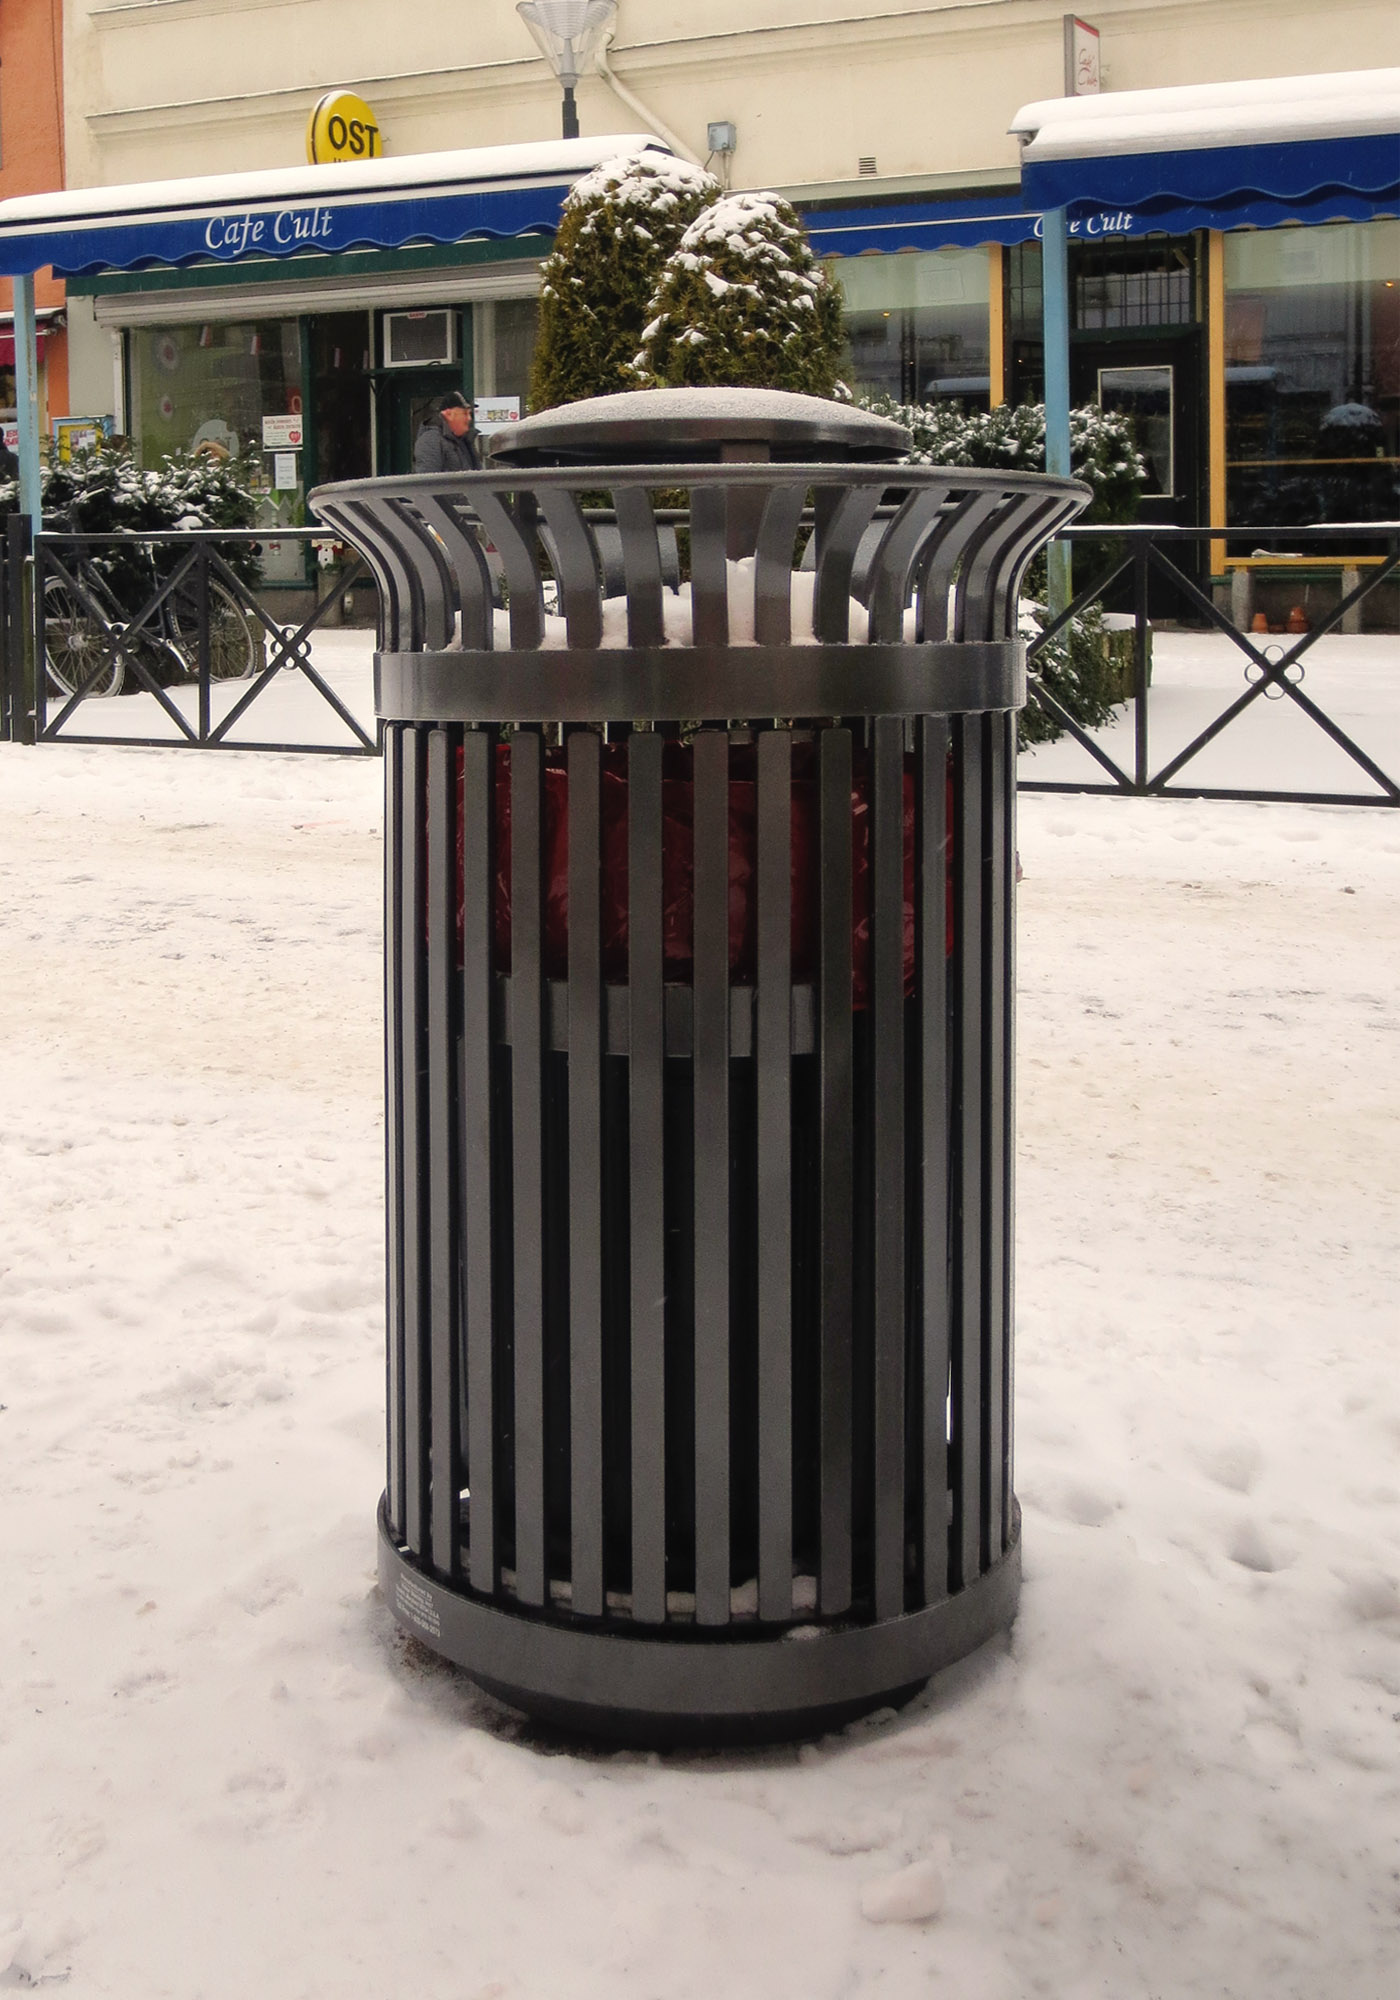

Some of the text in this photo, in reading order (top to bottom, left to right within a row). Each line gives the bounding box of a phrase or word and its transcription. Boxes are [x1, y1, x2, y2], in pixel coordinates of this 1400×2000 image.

[328, 114, 379, 158] OST
[205, 207, 333, 255] Cafe Cult
[1033, 211, 1133, 238] Ce Cult
